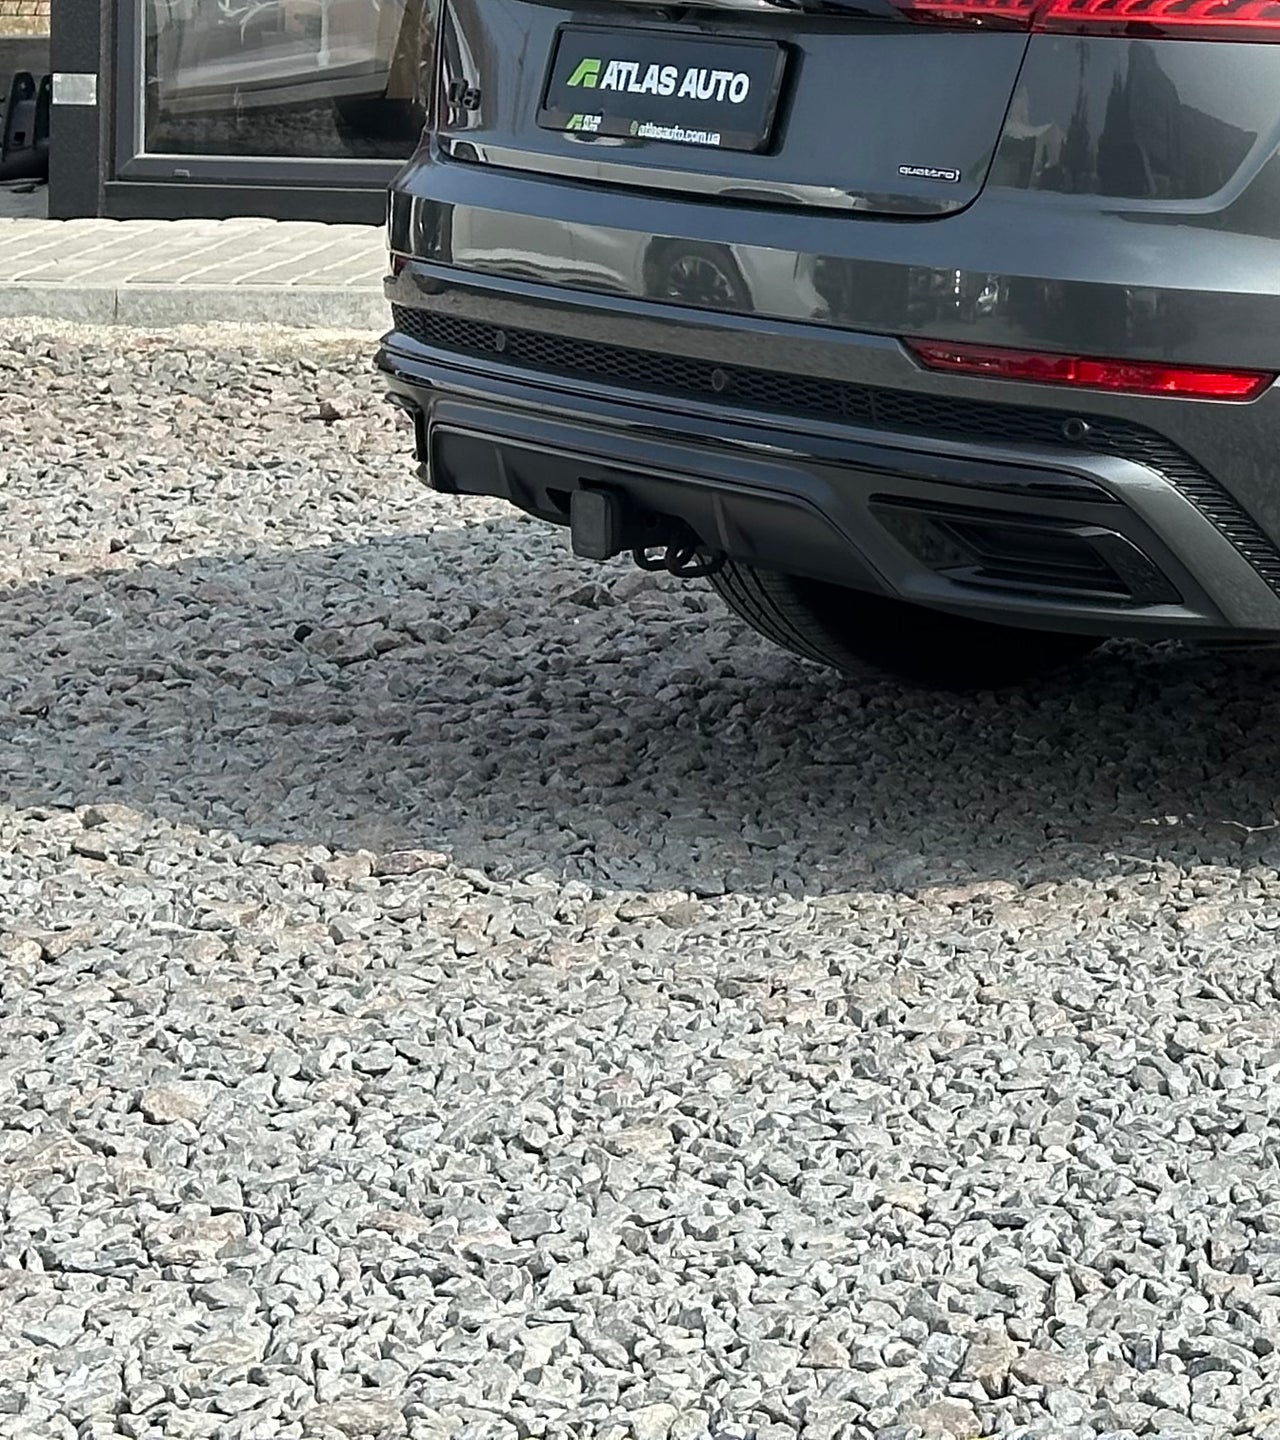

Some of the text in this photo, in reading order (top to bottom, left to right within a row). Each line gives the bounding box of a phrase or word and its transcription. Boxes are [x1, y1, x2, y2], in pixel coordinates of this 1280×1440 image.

[599, 60, 751, 105] ATLAS AUTO
[637, 122, 721, 146] atlasauto.com.ua
[898, 165, 956, 180] quattro
